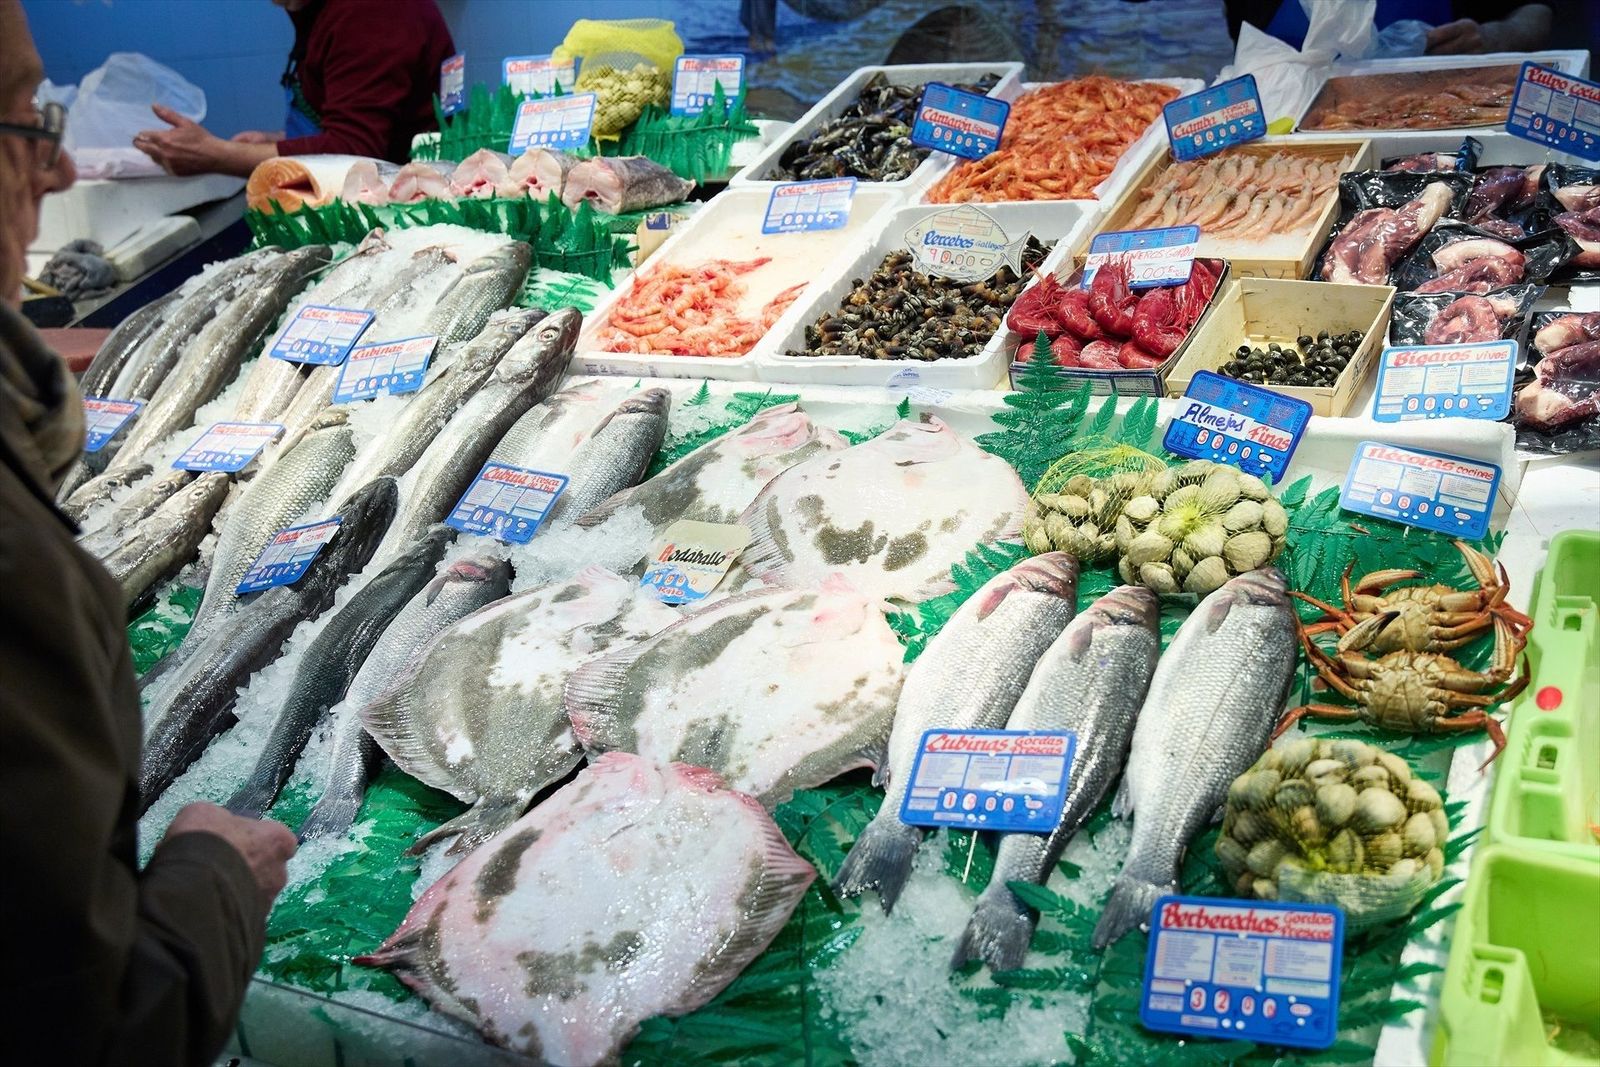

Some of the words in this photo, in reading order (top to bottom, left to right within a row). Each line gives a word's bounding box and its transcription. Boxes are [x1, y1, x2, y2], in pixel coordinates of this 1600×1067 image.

[1527, 67, 1568, 91] Pulpo
[924, 229, 975, 249] Percebes
[353, 343, 405, 361] Lubinas
[1179, 402, 1247, 432] Almejas
[483, 467, 528, 485] Lubina
[658, 542, 727, 567] Rodaballo
[927, 733, 1009, 753] Lubinas
[1014, 736, 1064, 747] Gordas
[1163, 901, 1282, 935] Berberechos
[1281, 911, 1333, 926] Gordos
